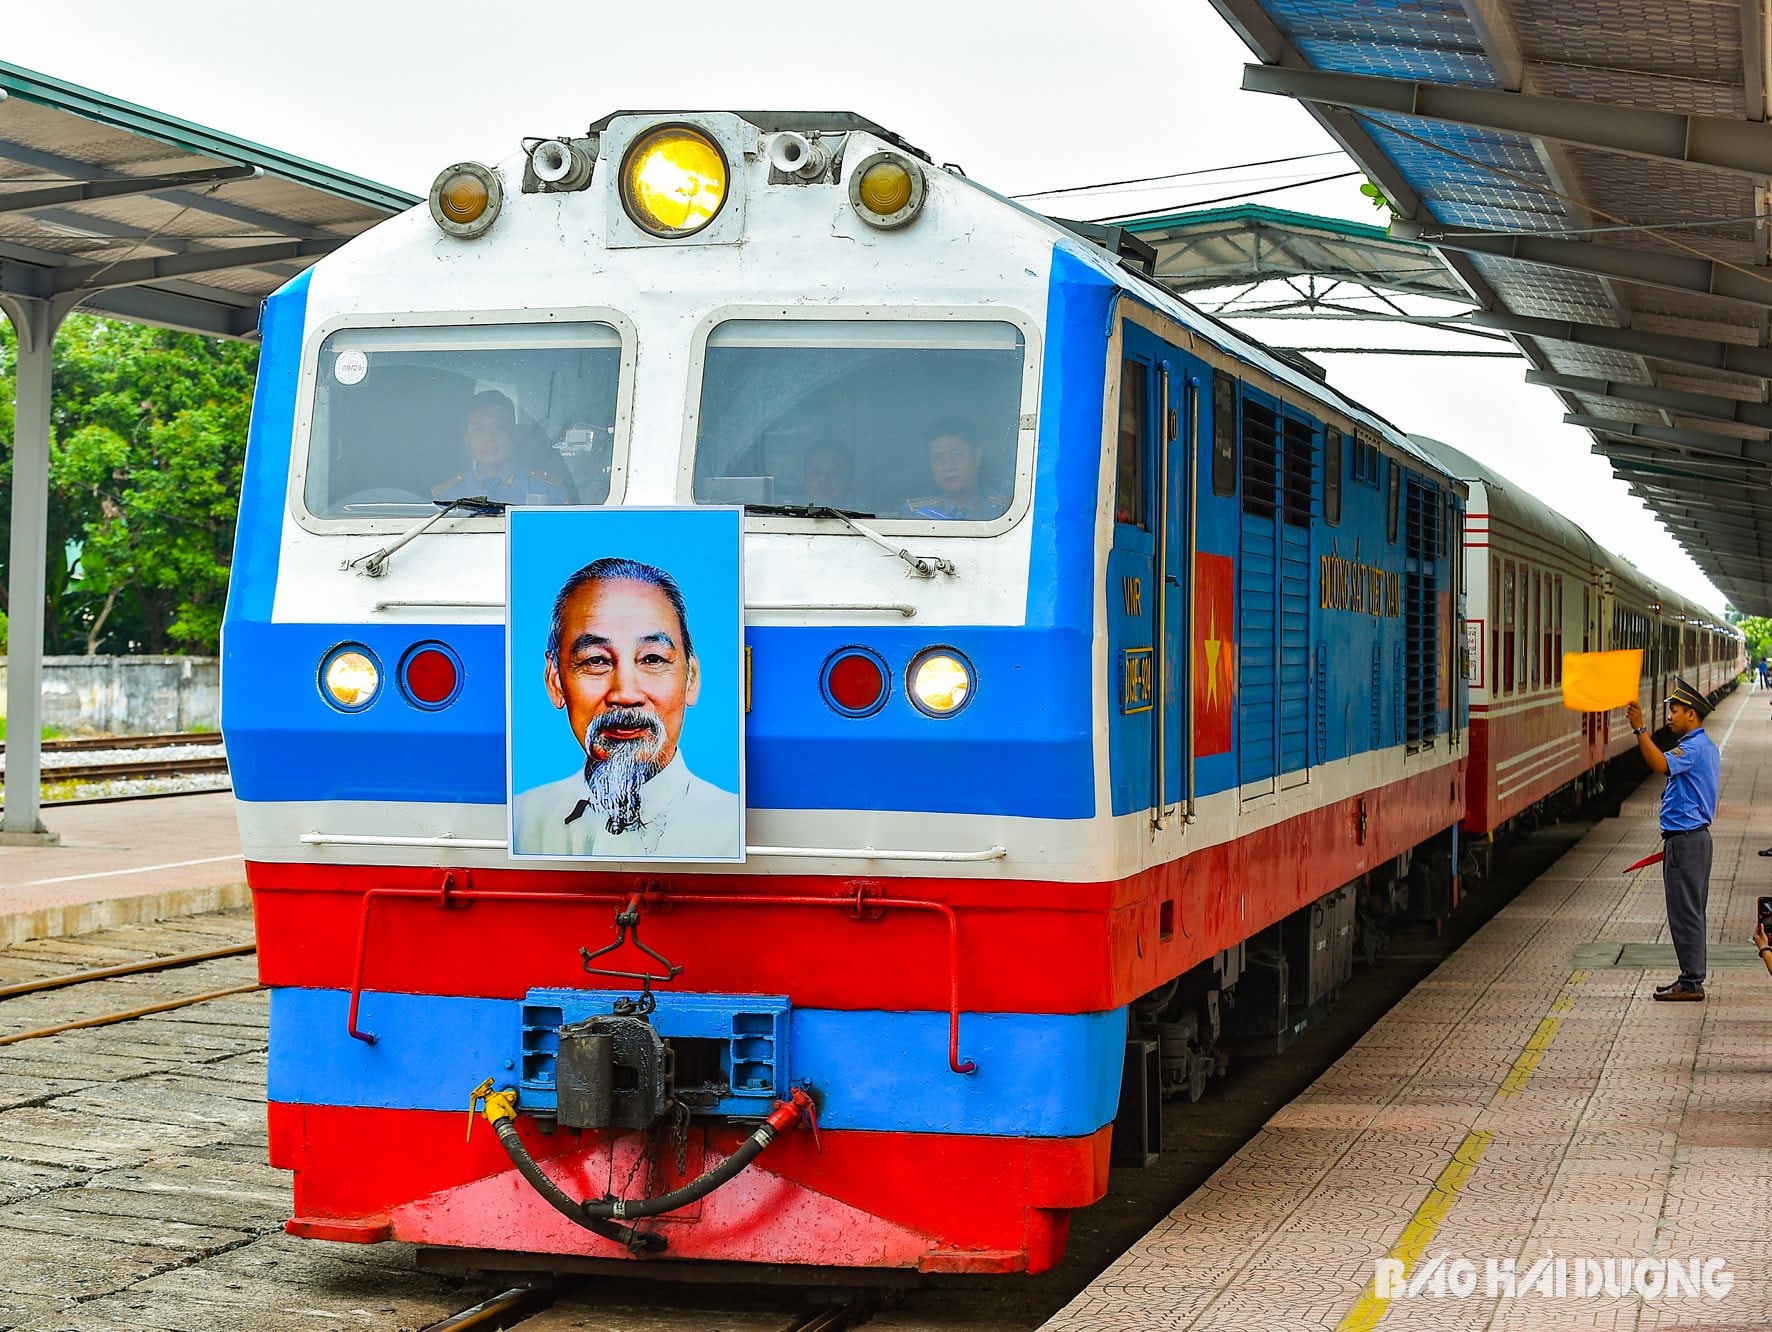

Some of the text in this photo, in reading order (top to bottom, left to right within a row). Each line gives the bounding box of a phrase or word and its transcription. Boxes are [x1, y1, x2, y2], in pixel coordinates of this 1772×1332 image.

[1122, 576, 1142, 616] VNR
[1320, 536, 1400, 628] ĐƯỜNG SẮT VIỆT NAM
